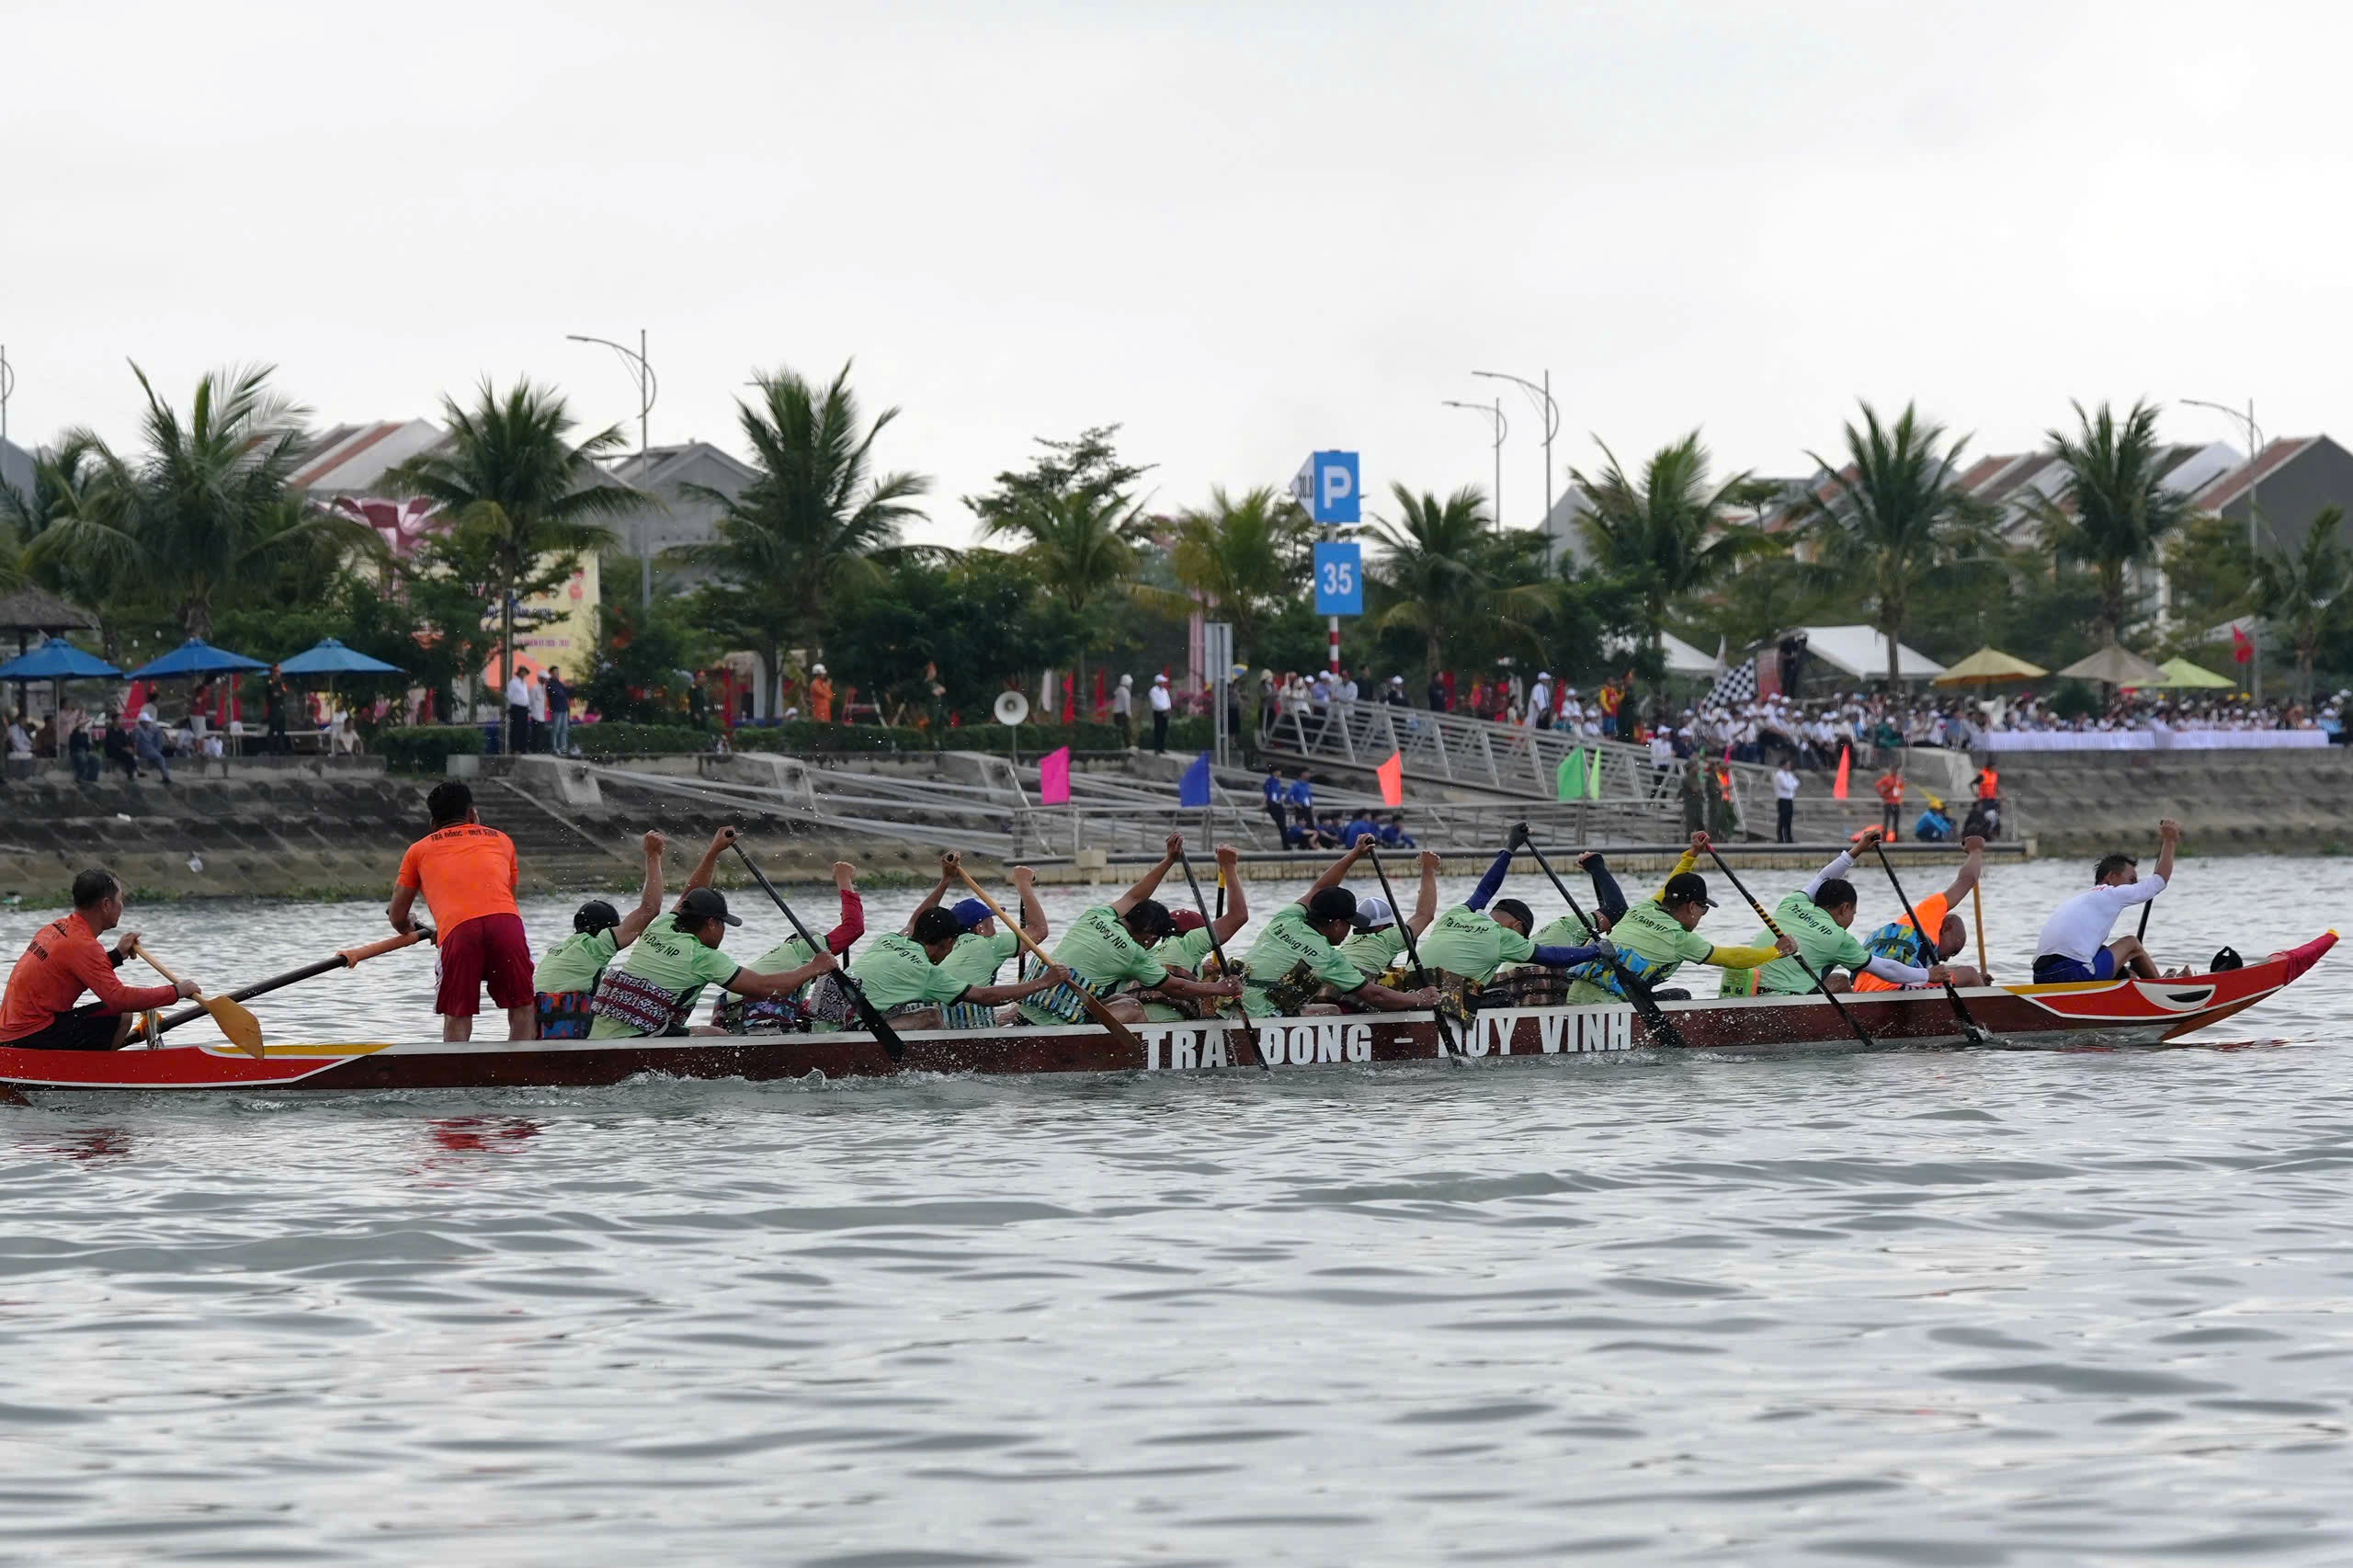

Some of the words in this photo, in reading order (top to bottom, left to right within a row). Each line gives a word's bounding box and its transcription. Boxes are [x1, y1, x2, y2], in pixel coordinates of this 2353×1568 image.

[1298, 476, 1313, 499] 30.8
[1324, 466, 1352, 508] P
[1323, 562, 1353, 596] 35
[1818, 925, 1833, 936] NP
[664, 945, 680, 958] NP
[1111, 936, 1128, 949] NP
[1301, 945, 1318, 957] NP
[1142, 1029, 1228, 1071] TRA
[1539, 1013, 1632, 1053] VINH
